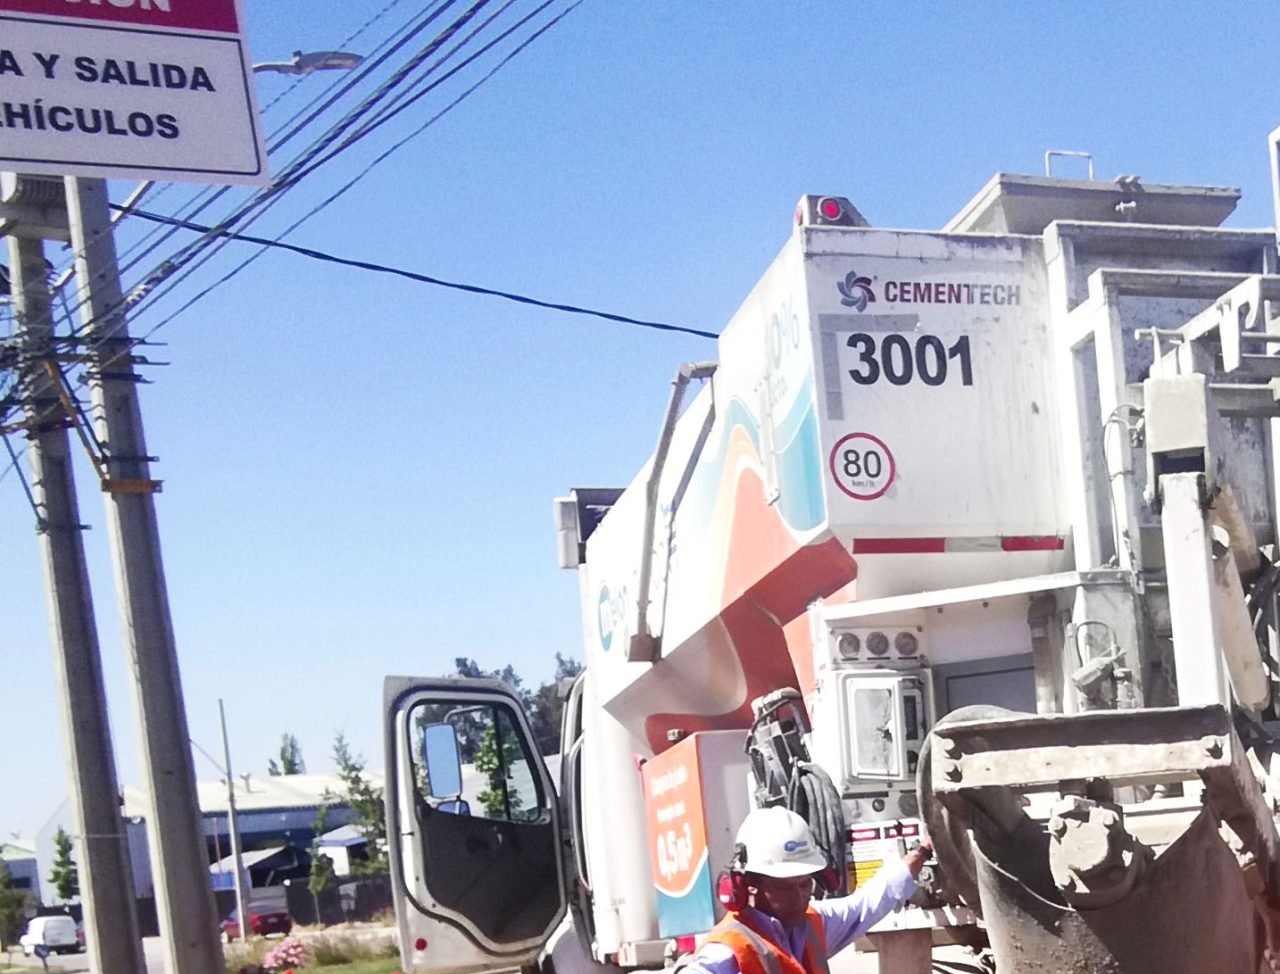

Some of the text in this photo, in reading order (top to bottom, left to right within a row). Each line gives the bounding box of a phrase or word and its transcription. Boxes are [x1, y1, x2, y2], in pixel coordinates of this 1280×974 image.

[32, 51, 61, 79] Y
[74, 56, 216, 92] SALIDA
[0, 97, 180, 139] HÍCULOS
[884, 281, 1021, 306] CEMENTECH
[847, 332, 973, 387] 3001
[843, 449, 882, 478] 80
